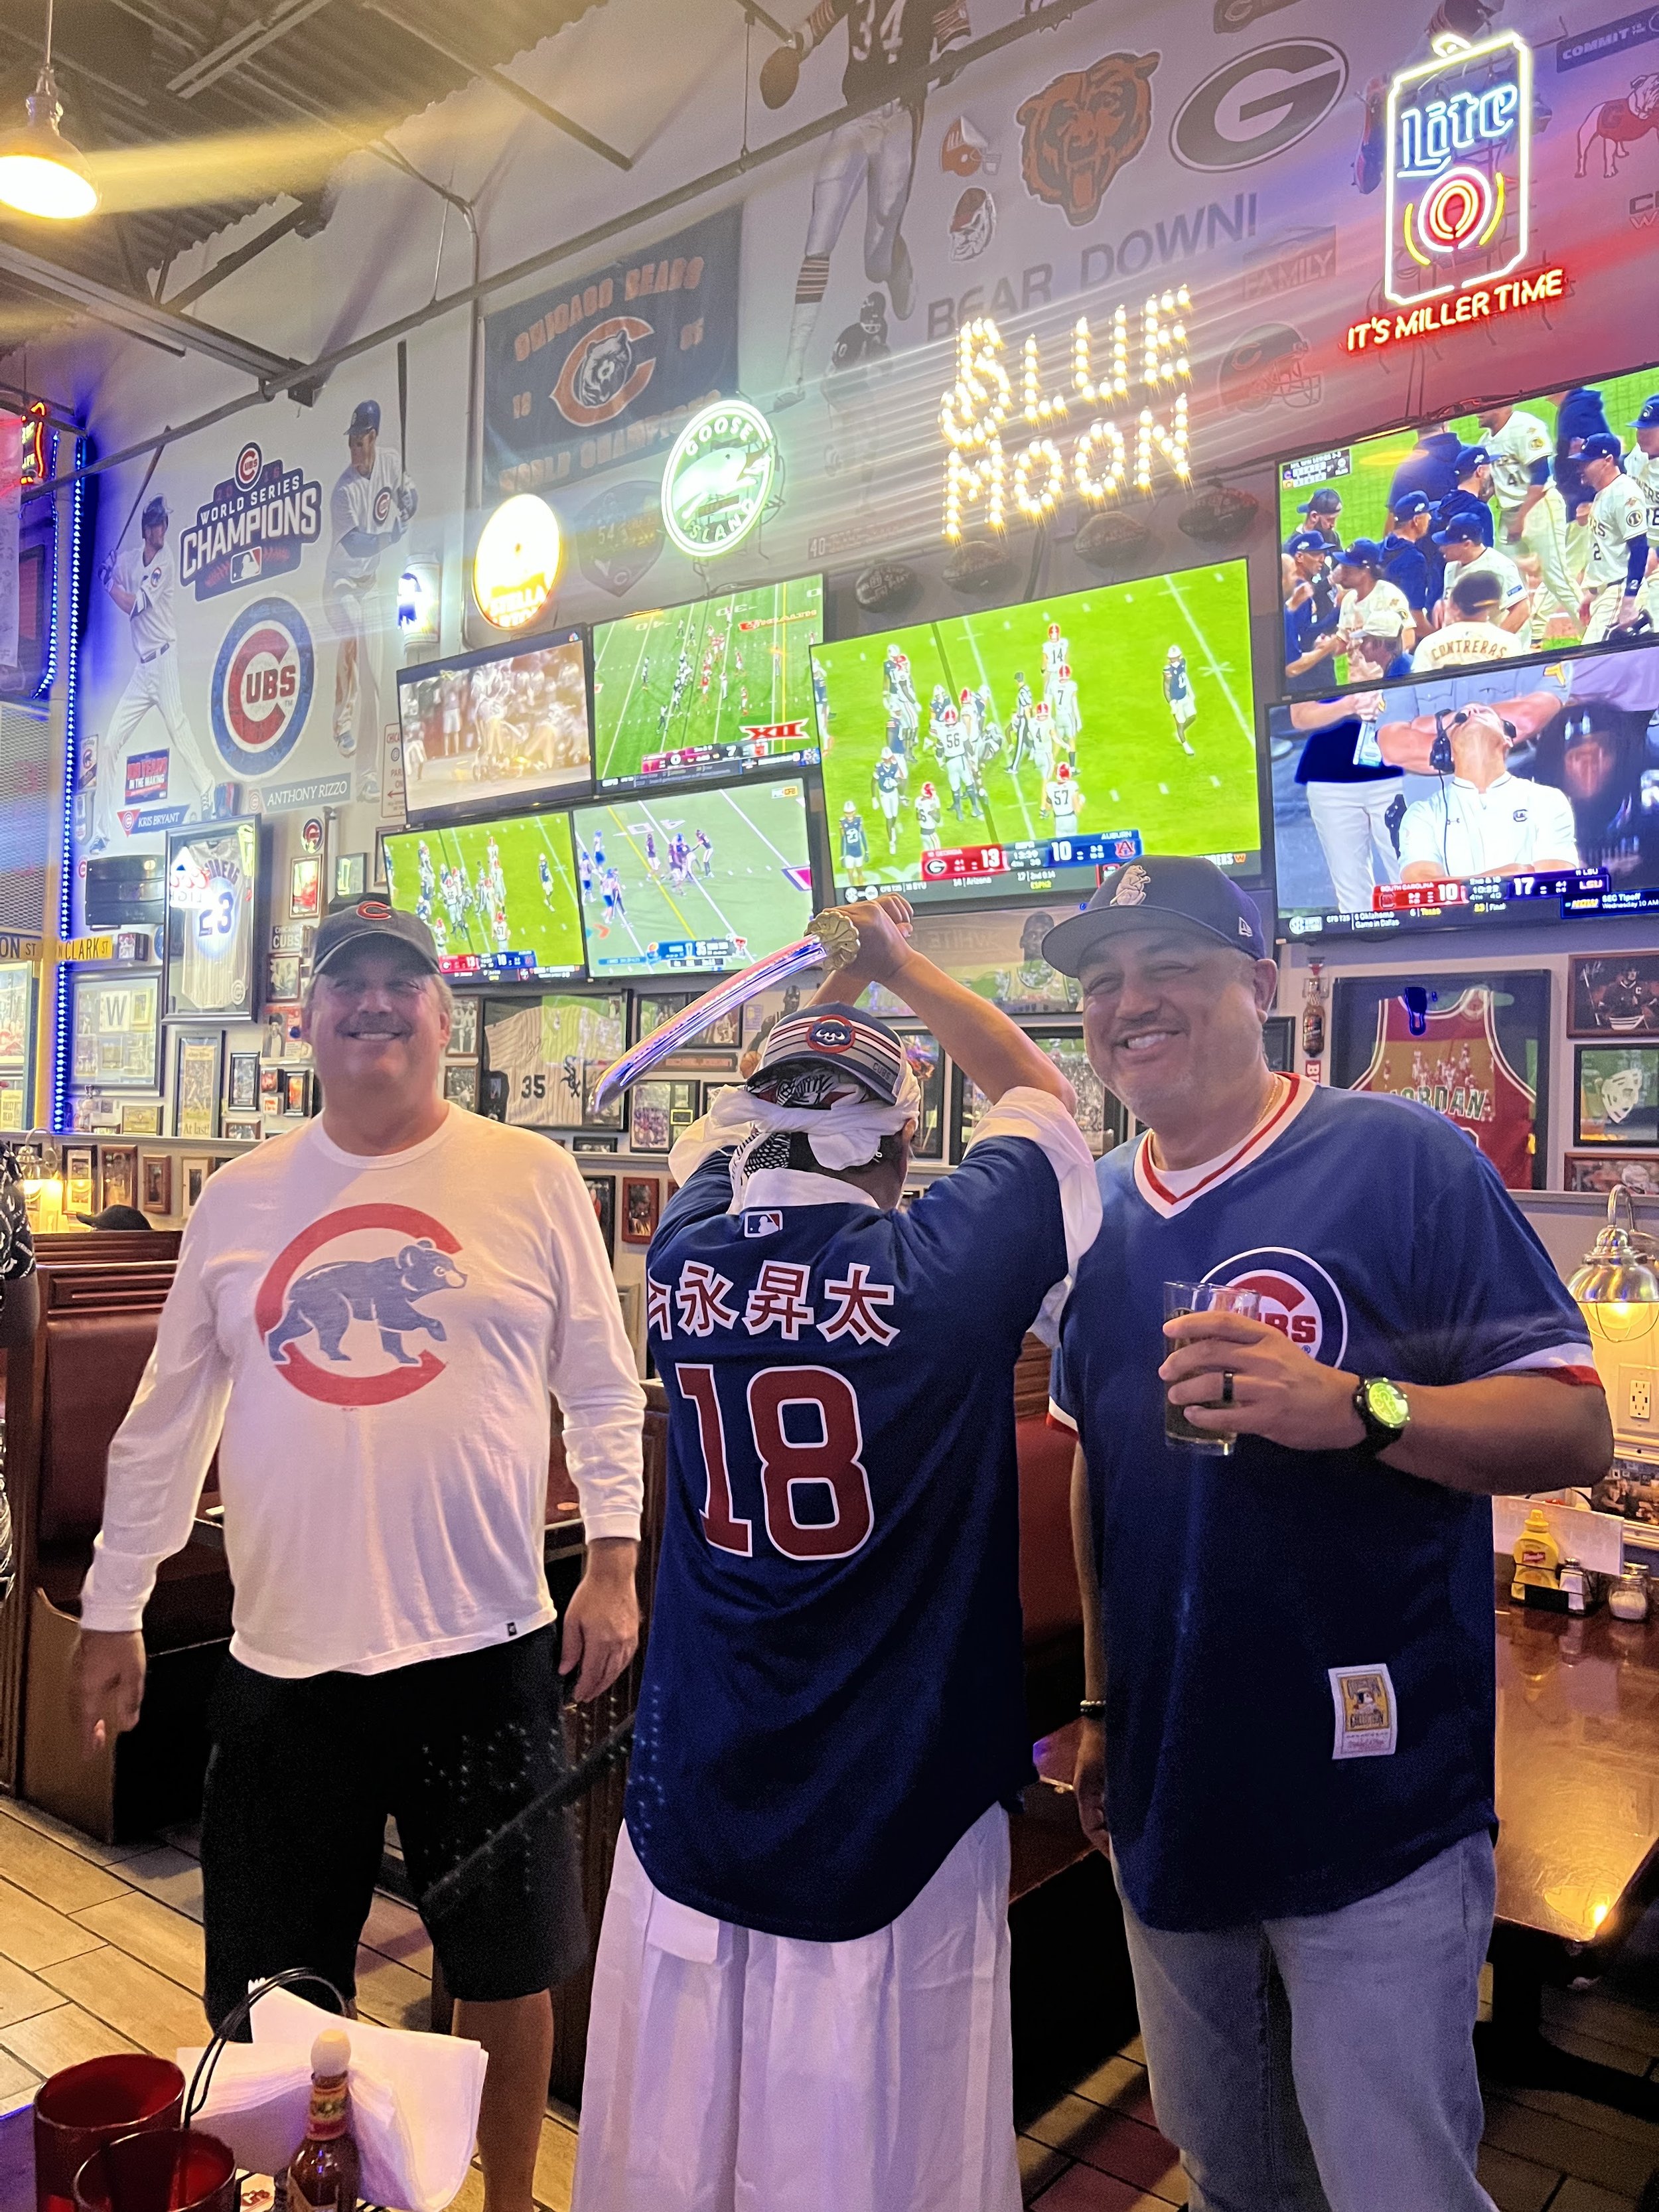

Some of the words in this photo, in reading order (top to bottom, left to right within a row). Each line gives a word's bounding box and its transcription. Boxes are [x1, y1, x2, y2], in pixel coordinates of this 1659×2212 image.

[1562, 27, 1629, 60] COMMIT
[1398, 84, 1518, 177] Lite
[1244, 248, 1334, 300] FAMILY
[514, 277, 613, 362] CHICAGO
[624, 256, 705, 301] BEARS
[928, 263, 1054, 341] BEAR
[1347, 316, 1392, 352] IT'S
[1394, 291, 1490, 340] MILLER
[1493, 268, 1563, 311] TIME
[953, 283, 1193, 431] BLUE
[685, 415, 754, 457] GOOSE
[940, 393, 1194, 539] MOON
[200, 496, 245, 525] WORLD
[250, 475, 300, 506] SERIES
[683, 498, 755, 544] ISLAND
[182, 487, 318, 579] CHAMPIONS
[1052, 647, 1064, 664] 14
[1430, 639, 1508, 662] CONTRERAS
[1057, 690, 1064, 705] 7
[946, 732, 960, 749] 56
[1035, 727, 1042, 743] 4
[725, 745, 737, 757] 7
[135, 778, 144, 789] THE
[267, 785, 318, 807] ANTHONY
[318, 780, 348, 798] RIZZO
[1054, 790, 1069, 806] 57
[138, 816, 153, 828] KRIS
[153, 812, 180, 826] BRYANT
[1100, 831, 1132, 840] AUBURN
[981, 848, 1000, 868] 13
[1050, 840, 1072, 862] 10
[1402, 882, 1435, 891] CAROLINA
[1437, 883, 1458, 902] 10
[1513, 877, 1534, 896] 17
[1579, 879, 1603, 890] LSU
[1488, 902, 1507, 911] Final
[1601, 894, 1618, 903] SEC
[1618, 892, 1642, 902] Tipoff
[1601, 901, 1638, 911] Wednesday
[1647, 899, 1659, 907] AM
[1359, 911, 1395, 921] Oklahoma
[1420, 907, 1442, 916] Texas
[1354, 921, 1374, 929] Game
[1380, 919, 1401, 928] Dallas
[25, 943, 36, 956] ST
[58, 944, 62, 957] N
[66, 936, 100, 960] CLARK
[102, 940, 108, 954] ST
[273, 934, 301, 948] CUBS
[106, 995, 127, 1026] W
[872, 1062, 891, 1080] CUBS
[521, 1074, 546, 1099] 35
[183, 1124, 192, 1136] At
[194, 1123, 210, 1136] last!
[674, 1362, 875, 1561] 18
